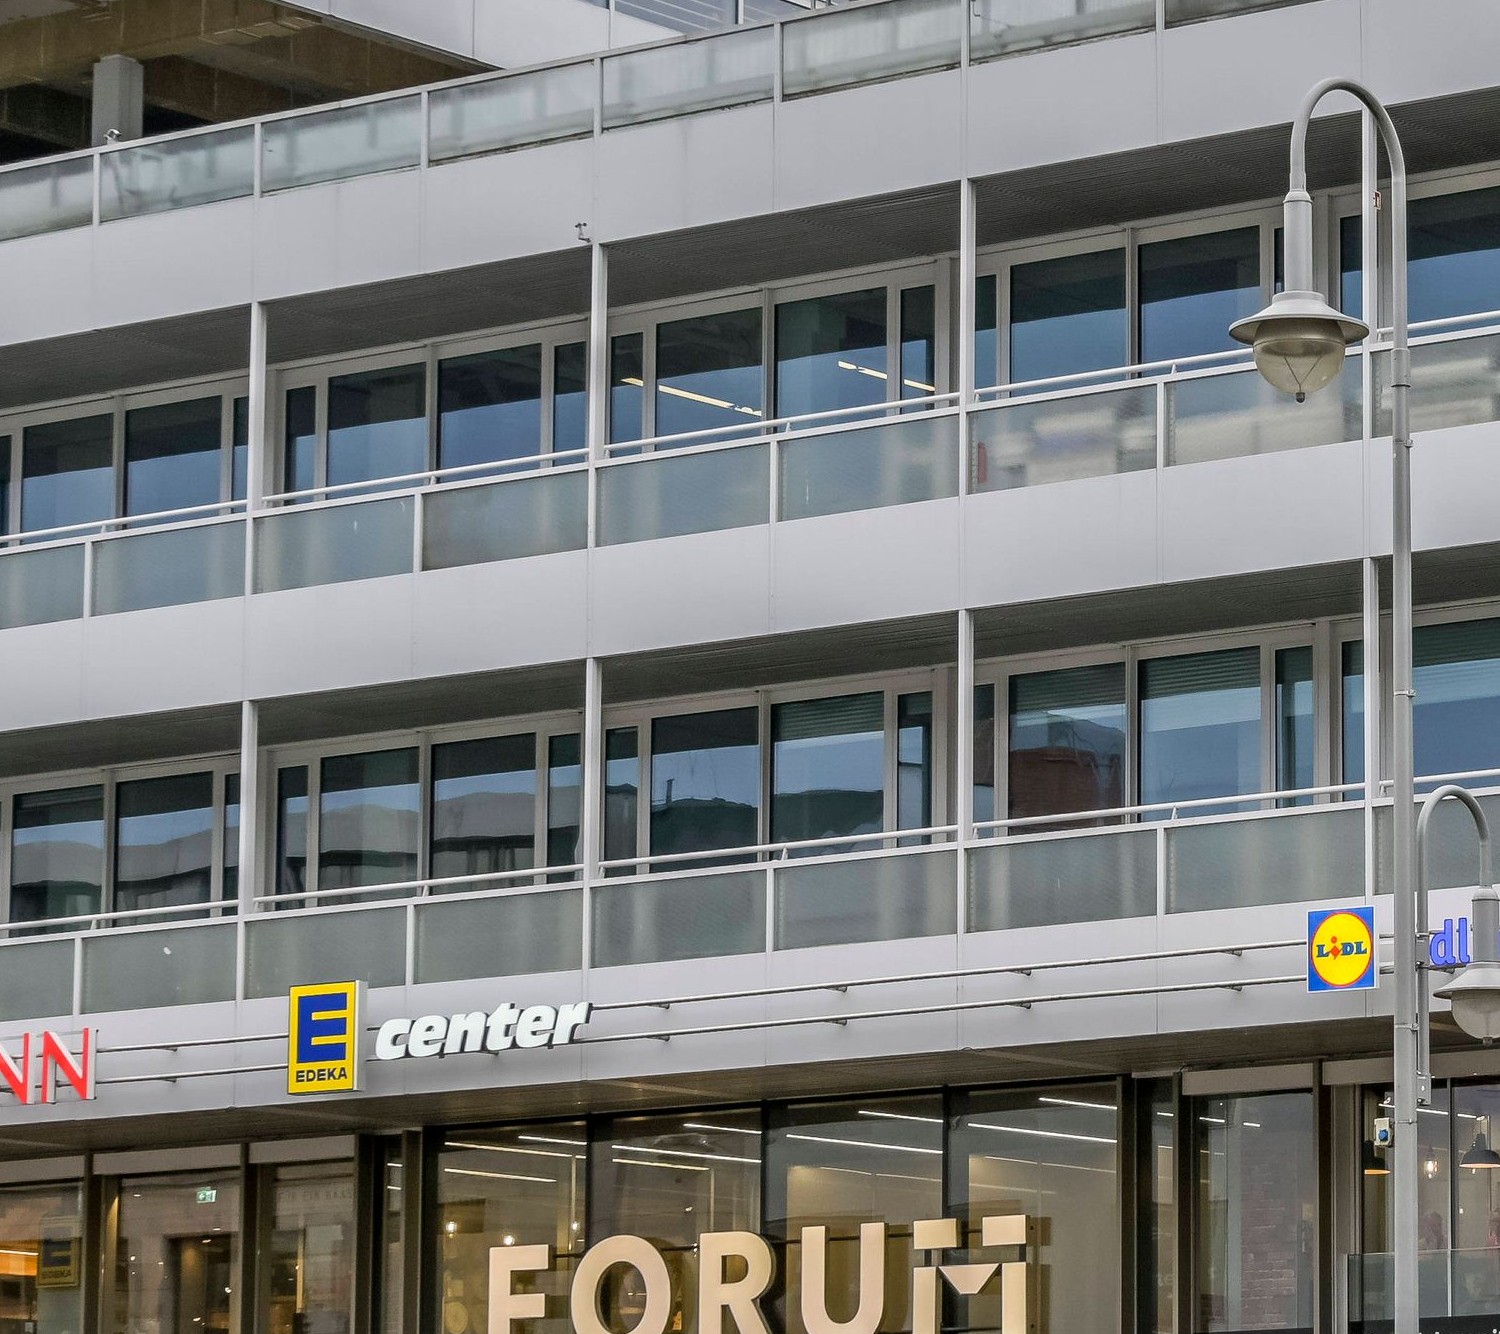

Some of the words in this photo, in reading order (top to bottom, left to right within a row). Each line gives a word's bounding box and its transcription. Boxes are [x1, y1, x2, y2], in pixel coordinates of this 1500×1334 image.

[1315, 934, 1368, 960] LIDL
[374, 1001, 592, 1061] center
[295, 1067, 348, 1084] EDEKA
